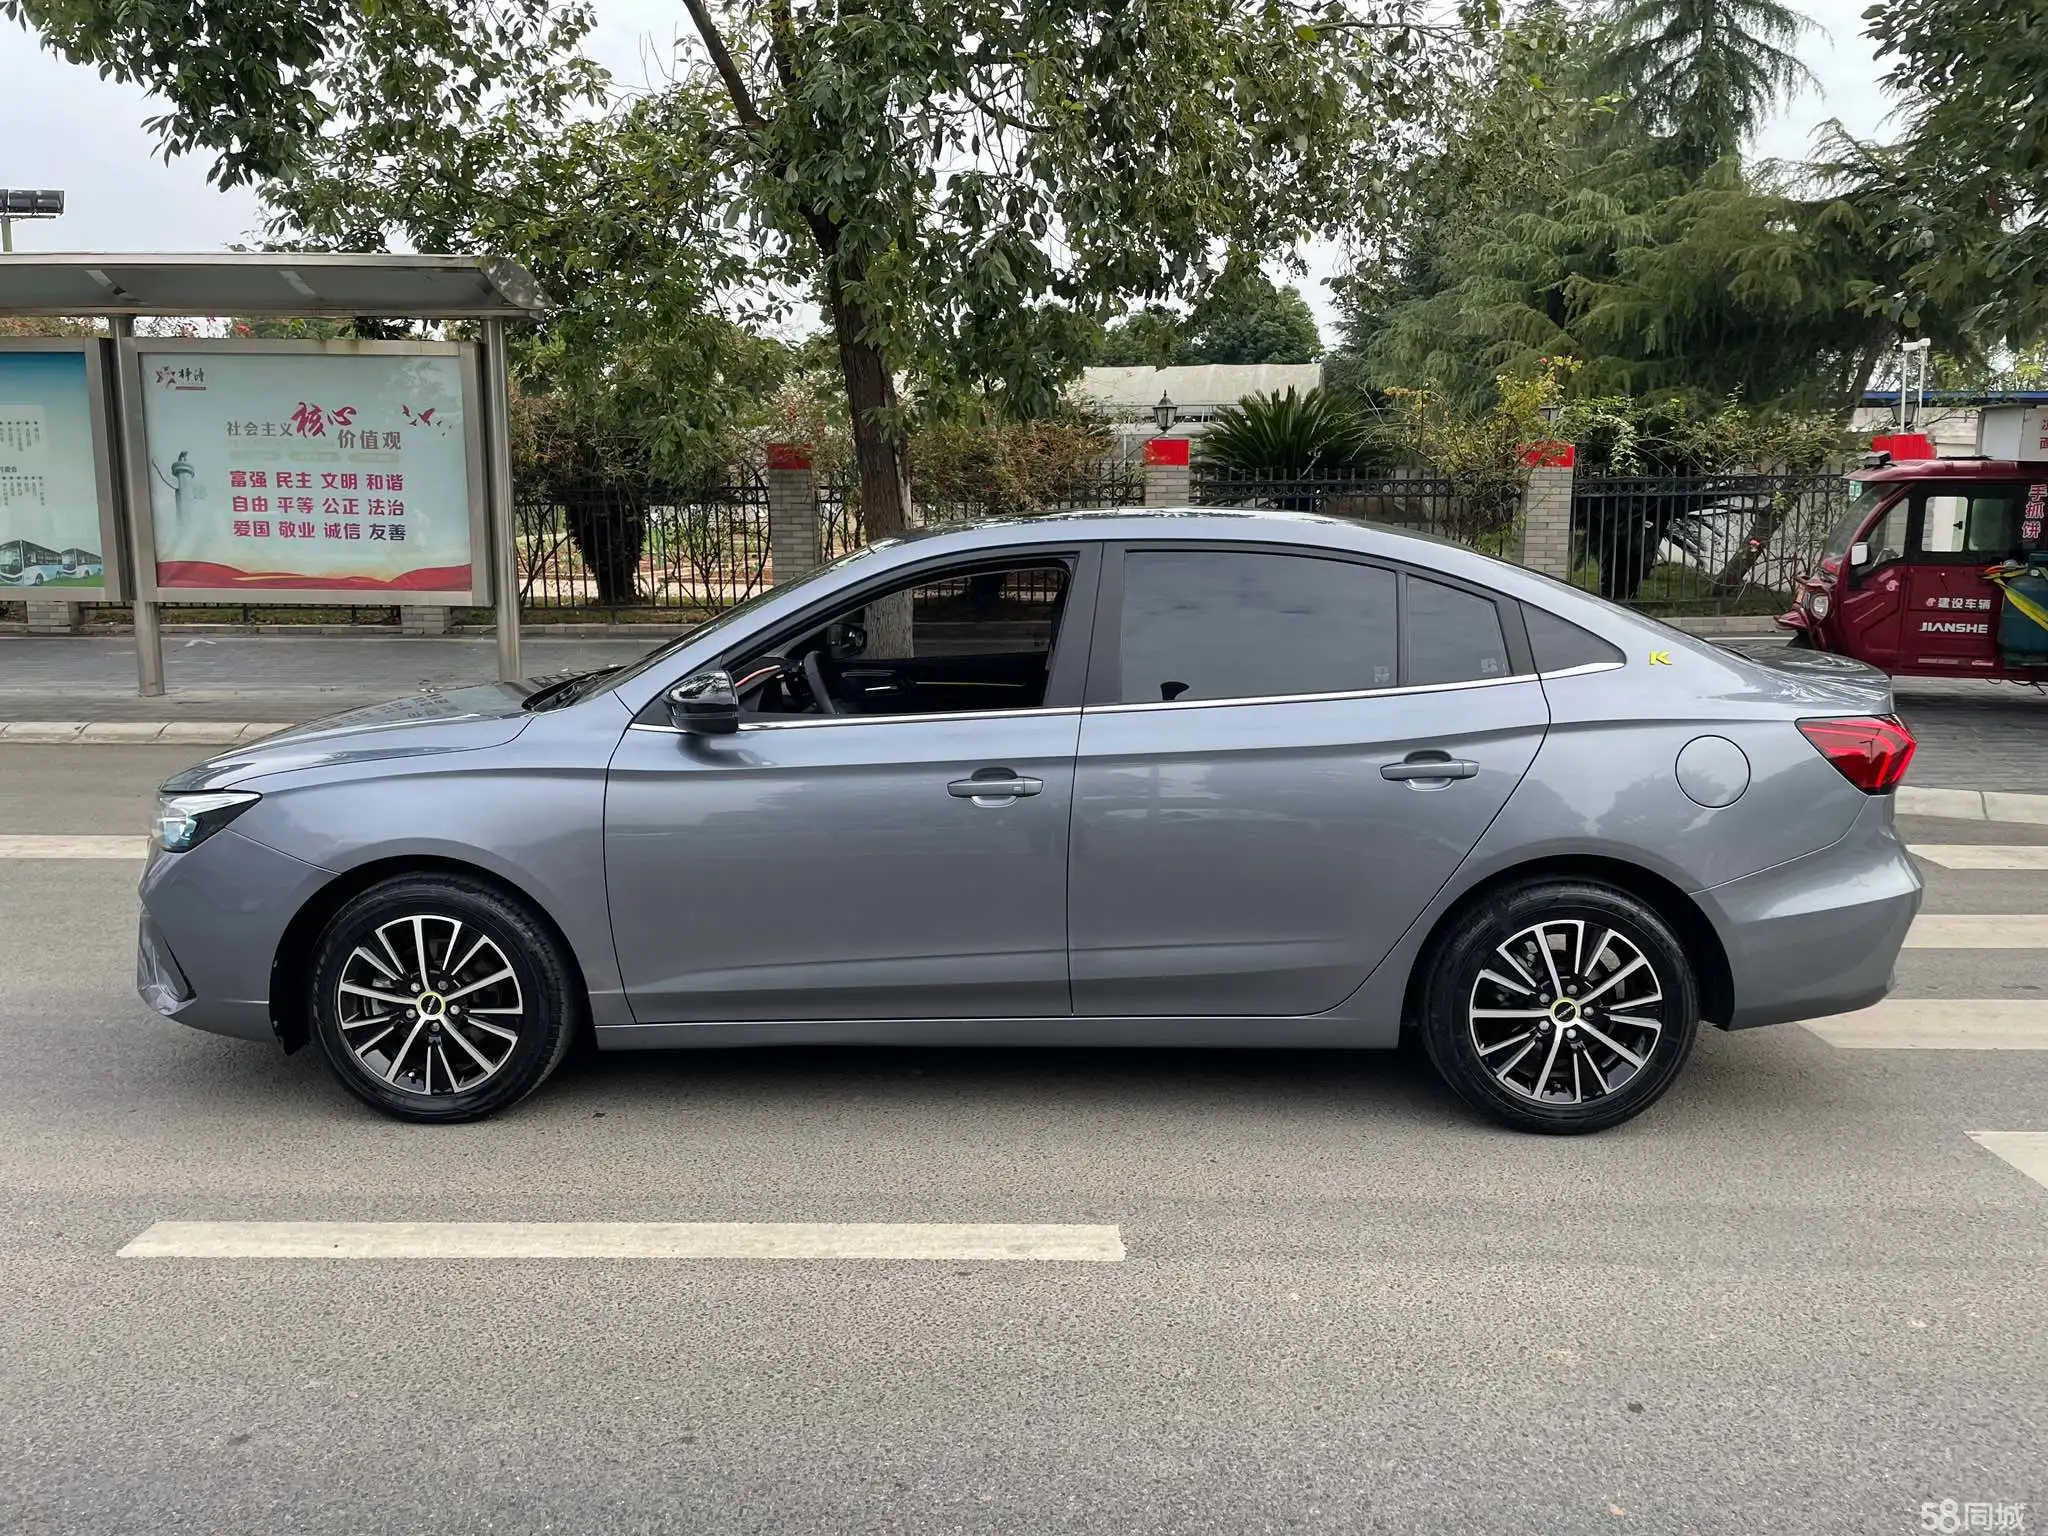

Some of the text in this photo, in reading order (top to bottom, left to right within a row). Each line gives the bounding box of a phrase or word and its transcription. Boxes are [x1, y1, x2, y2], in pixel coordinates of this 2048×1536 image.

[227, 400, 402, 450] 社会主义 核心 价值观
[230, 470, 404, 491] 富强 民主 文明 和谐
[232, 496, 405, 516] 自由 平等 公正 法治
[2021, 484, 2048, 539] 手抓饼
[233, 520, 407, 541] 爱国 敬业 诚信 友善
[1937, 597, 1992, 610] 建设车辆
[1919, 621, 1989, 634] JIANSHE
